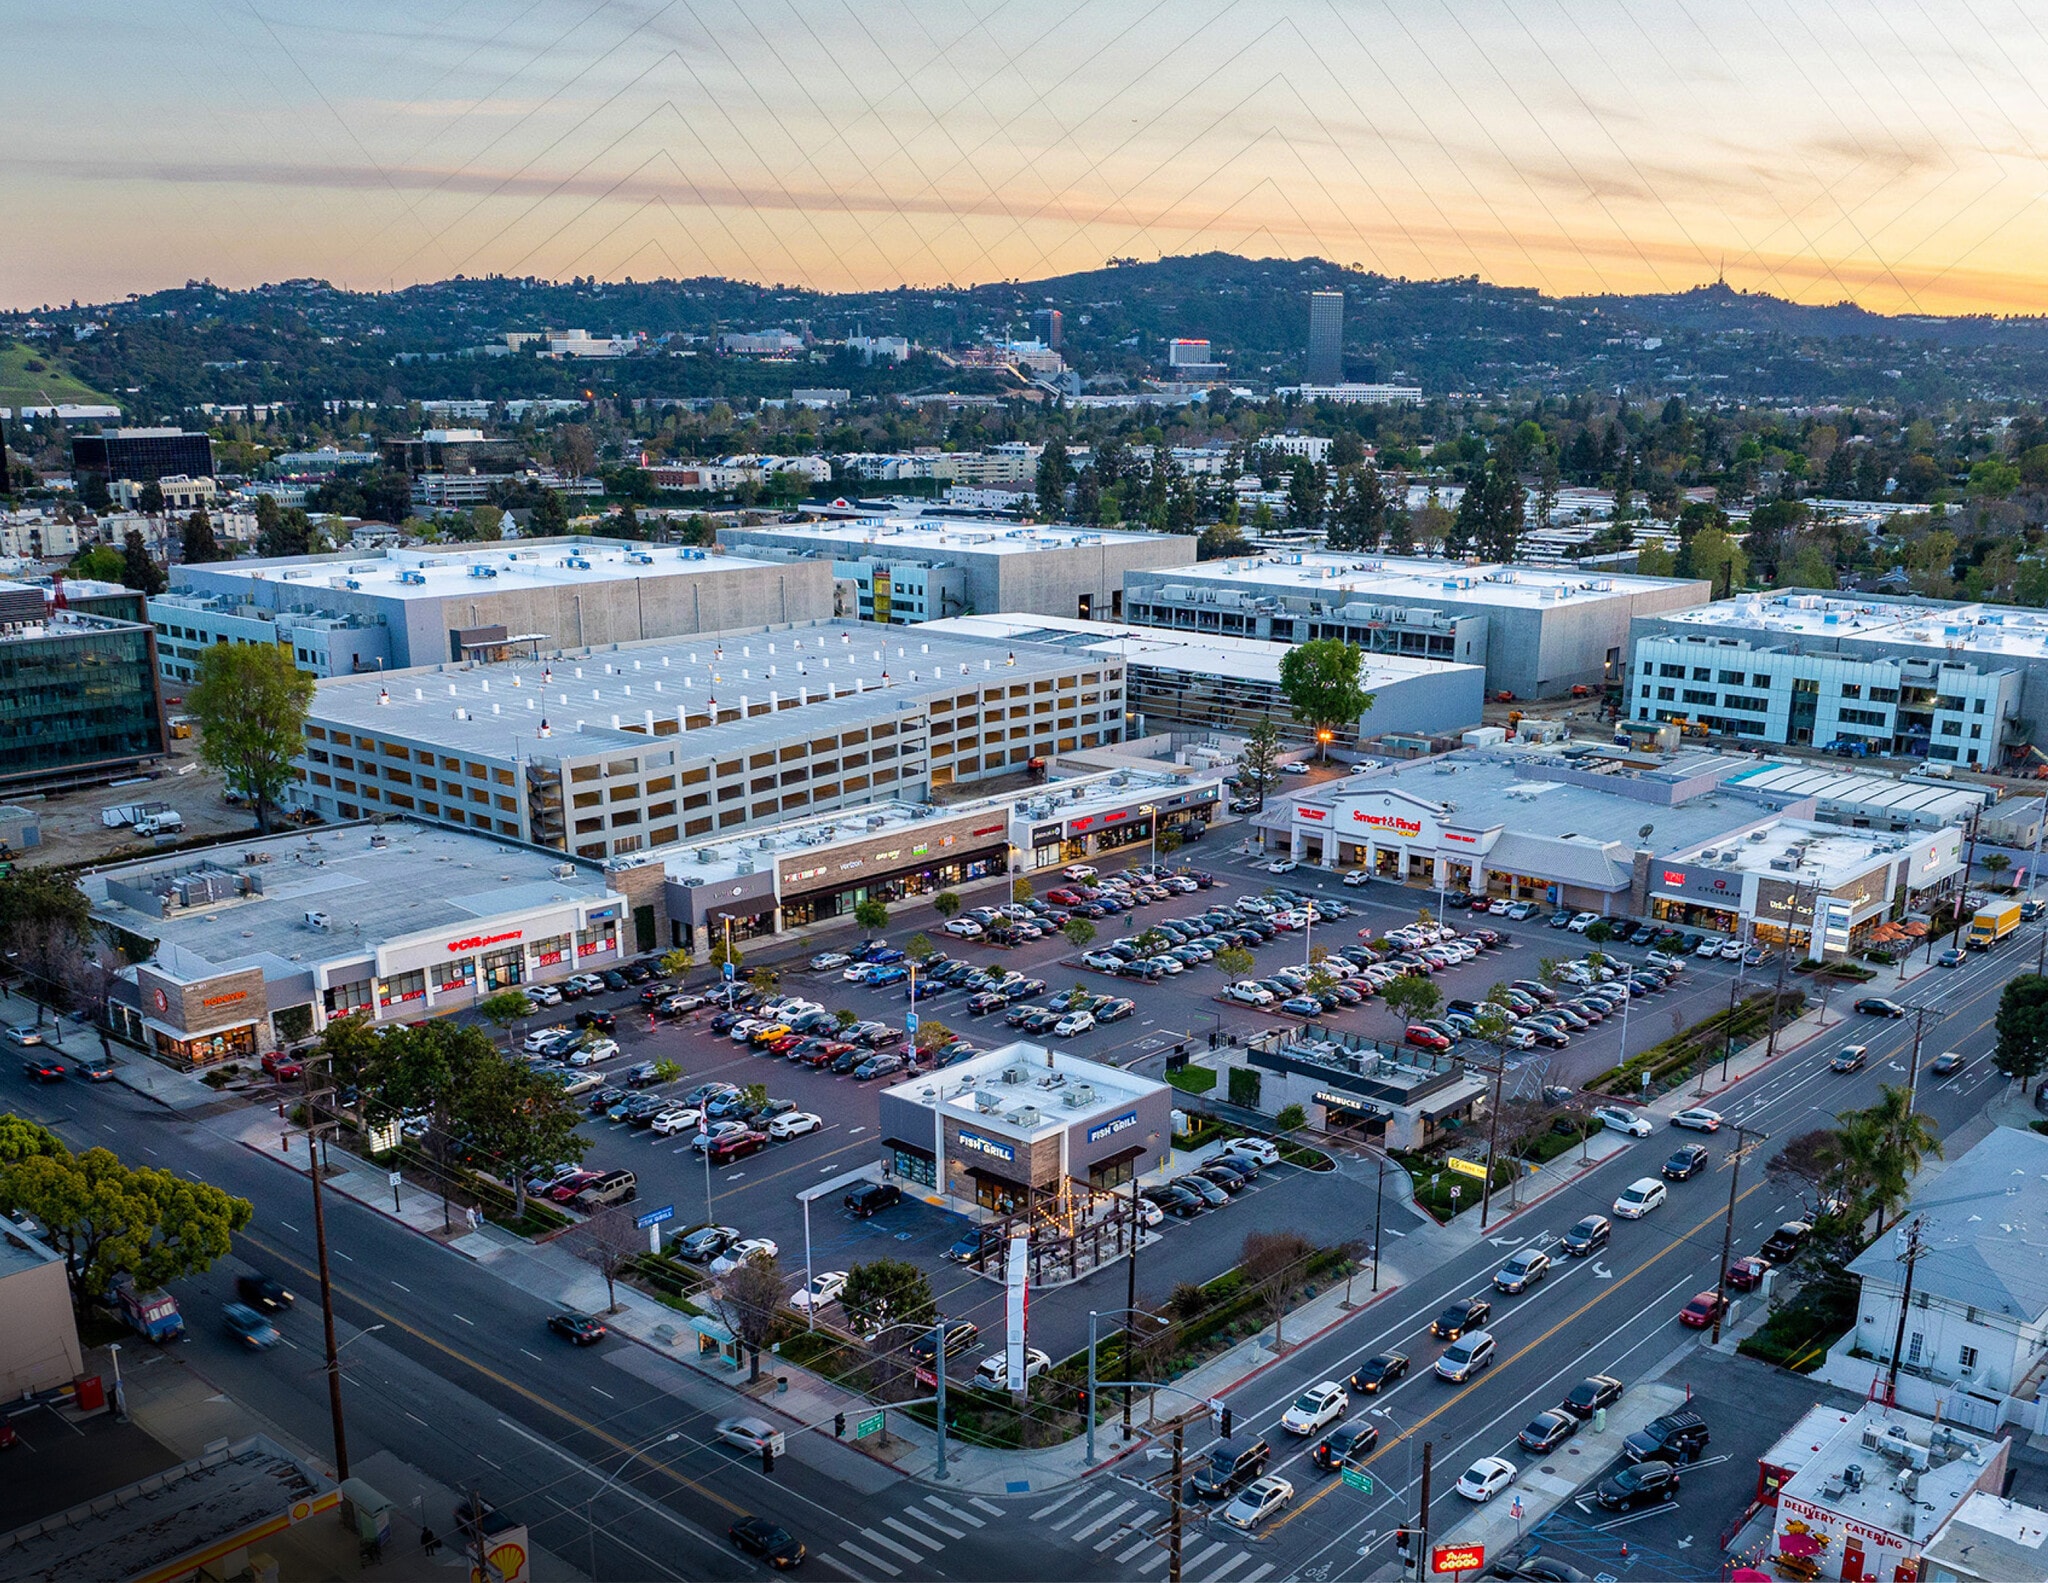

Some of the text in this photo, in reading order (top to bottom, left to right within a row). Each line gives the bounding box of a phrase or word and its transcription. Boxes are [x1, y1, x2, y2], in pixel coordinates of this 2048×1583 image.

[1353, 810, 1421, 832] Smart & Final
[459, 930, 523, 950] CVS pharmacy
[203, 990, 248, 1007] POPEYES
[1316, 1091, 1361, 1110] STARBUCKS
[1091, 1129, 1111, 1142] FISH
[1113, 1118, 1137, 1133] GRILL
[959, 1135, 981, 1151] FISH
[983, 1144, 1012, 1161] GRILL
[1784, 1499, 1903, 1549] DELIVERY CATERING
